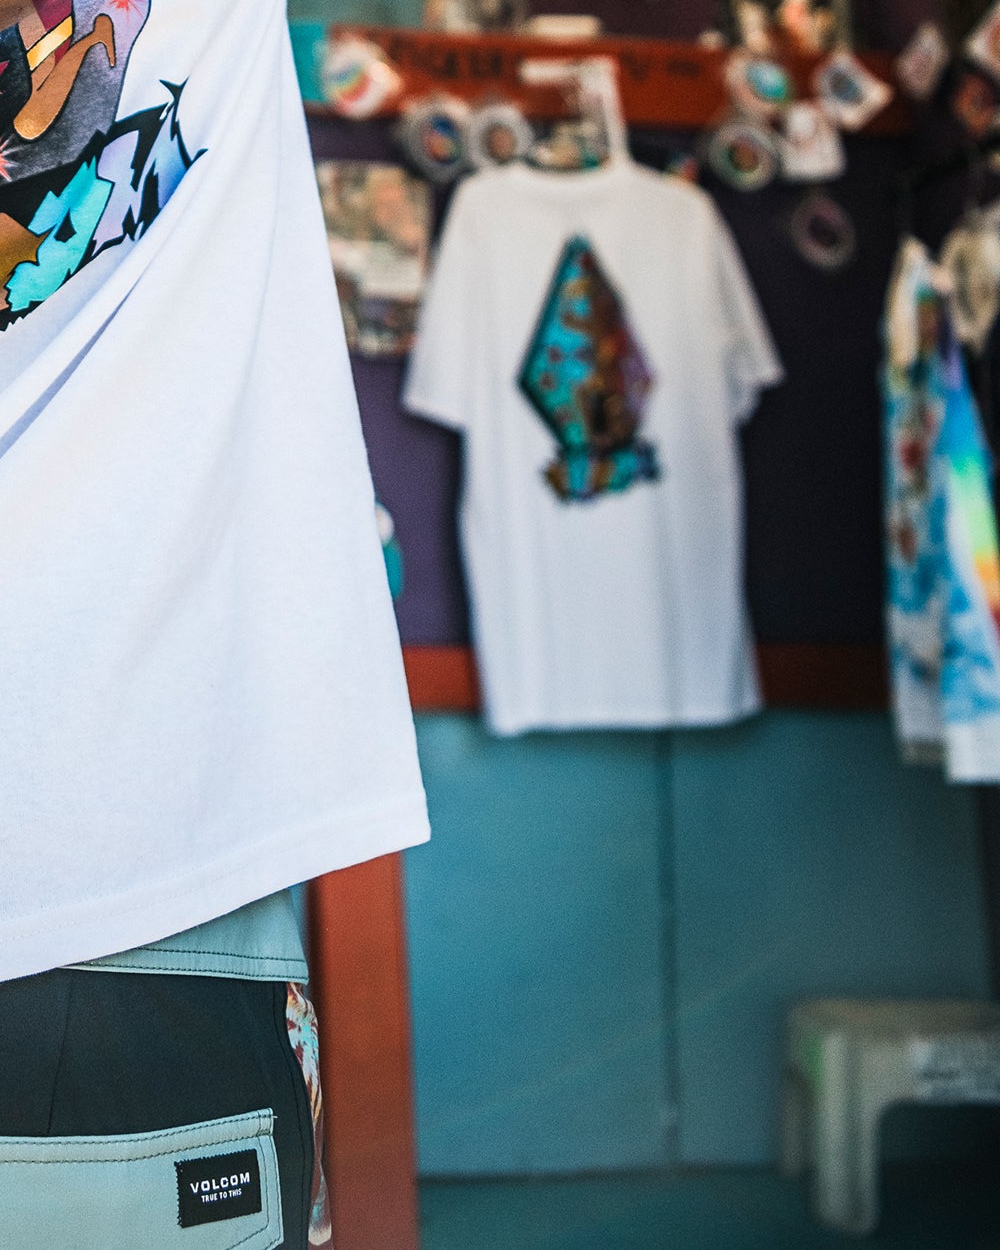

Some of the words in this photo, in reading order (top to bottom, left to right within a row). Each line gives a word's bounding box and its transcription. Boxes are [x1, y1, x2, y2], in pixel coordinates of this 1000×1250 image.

[190, 1172, 250, 1193] VOLCOM
[202, 1193, 218, 1203] TRUE
[219, 1191, 228, 1200] TO
[229, 1188, 242, 1198] THIS
